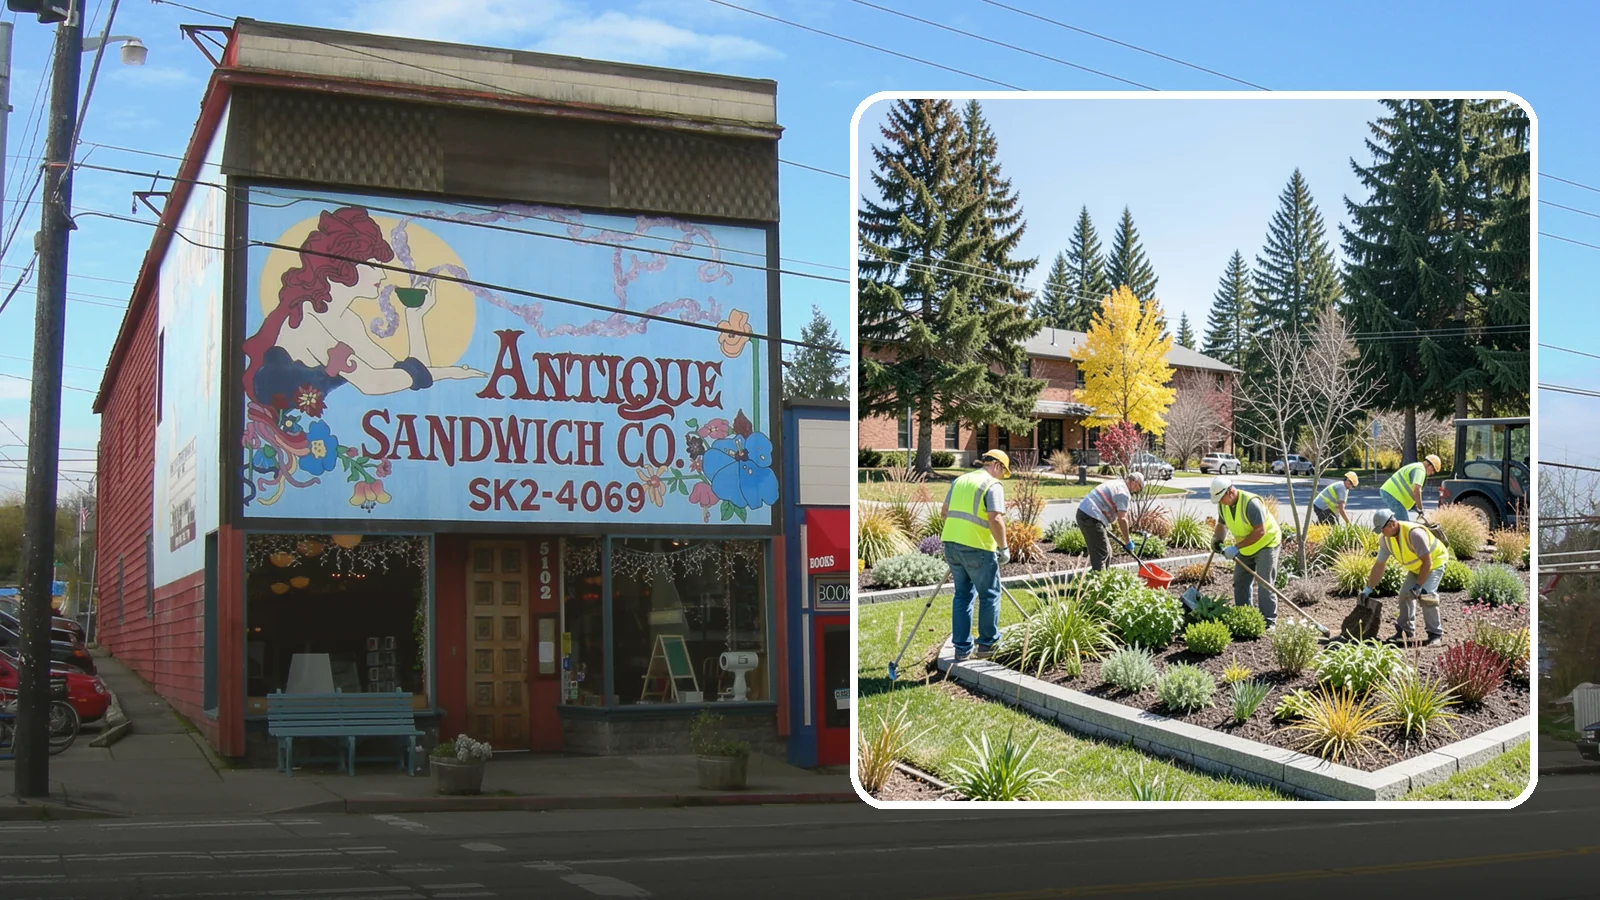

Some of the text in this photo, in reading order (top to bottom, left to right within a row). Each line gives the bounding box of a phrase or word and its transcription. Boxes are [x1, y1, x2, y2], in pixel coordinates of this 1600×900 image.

[476, 329, 723, 421] ANTIQUE
[361, 408, 685, 469] SANDWICH CO.
[469, 477, 645, 513] SK2-4069
[539, 541, 552, 600] 5102
[809, 555, 835, 569] BOOKS
